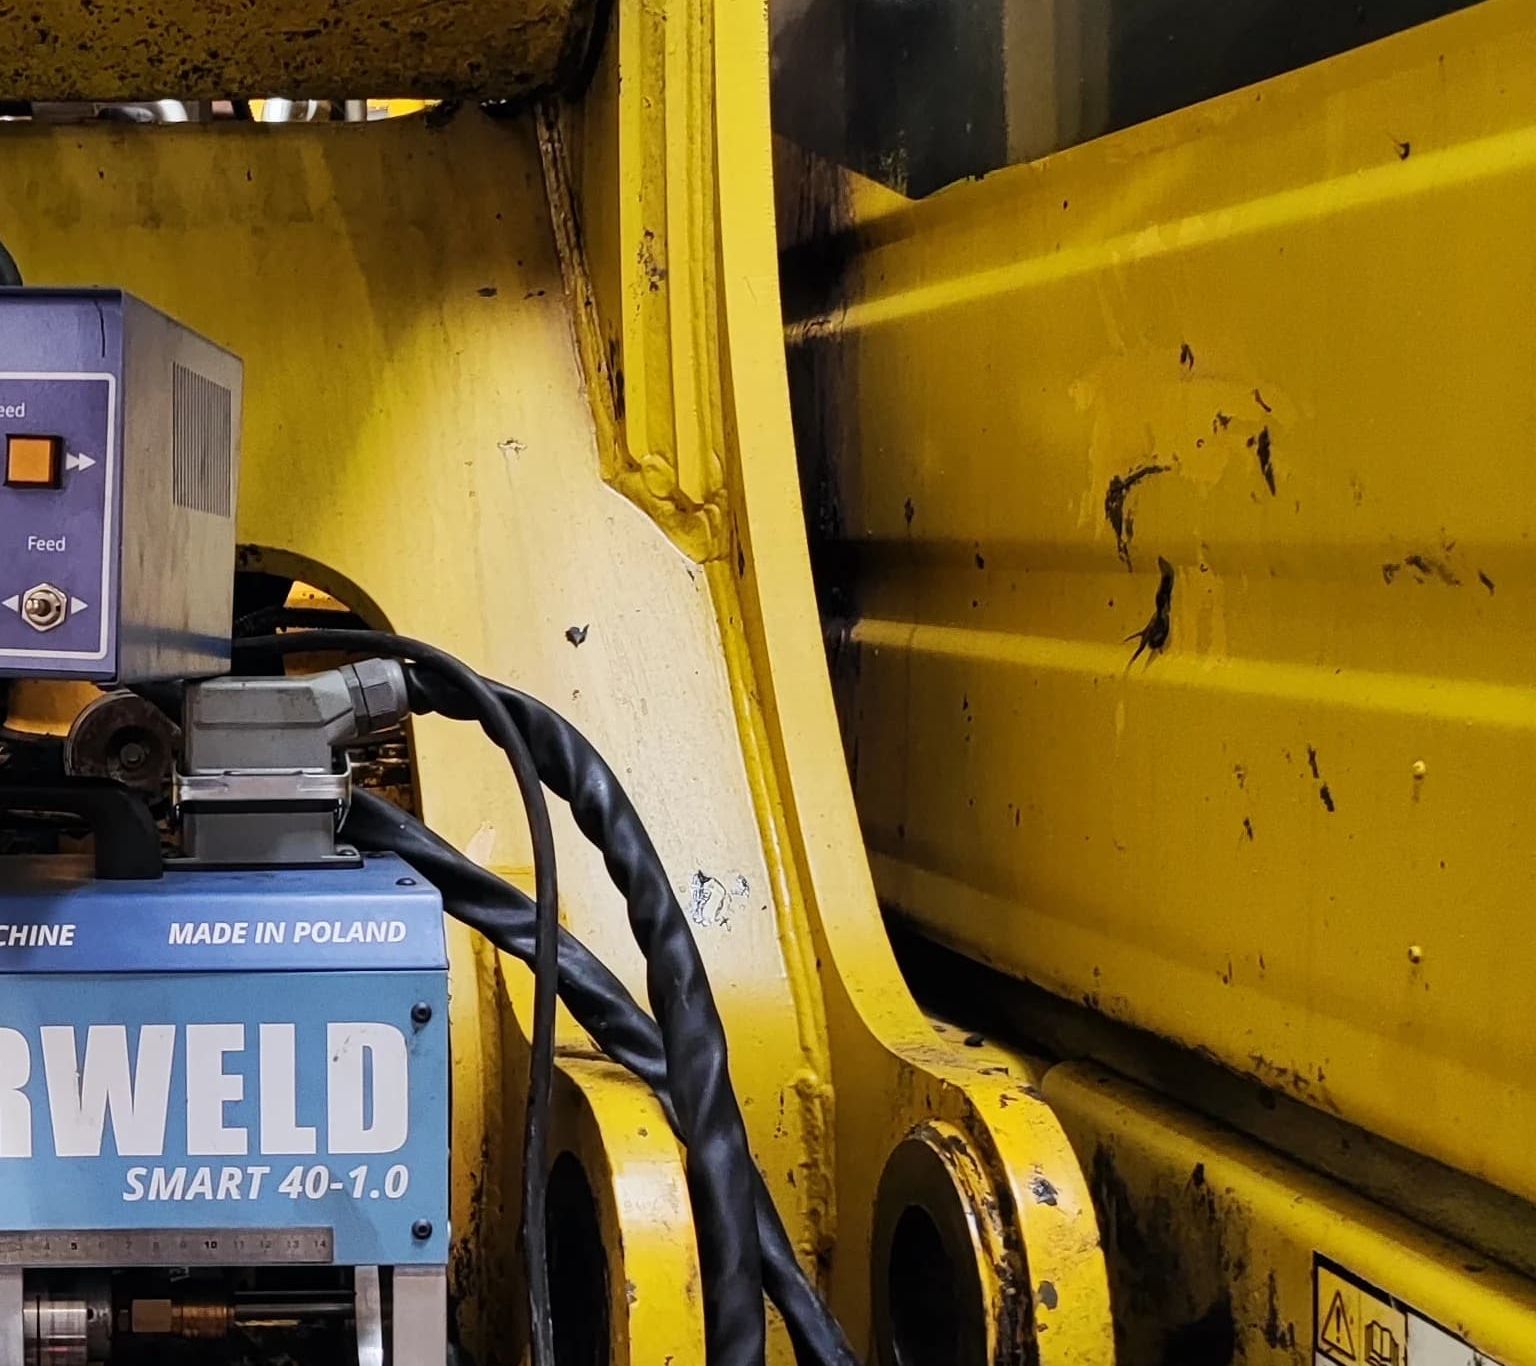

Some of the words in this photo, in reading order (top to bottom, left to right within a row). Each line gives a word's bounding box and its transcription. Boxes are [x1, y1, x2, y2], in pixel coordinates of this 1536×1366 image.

[27, 537, 65, 552] Feed
[167, 922, 248, 945] MADE
[253, 922, 285, 944] IN
[291, 920, 407, 945] POLAND
[123, 1167, 271, 1202] SMART
[278, 1165, 410, 1201] 40-1.0
[70, 1241, 78, 1251] 5
[204, 1240, 218, 1250] 10
[313, 1240, 327, 1249] 14
